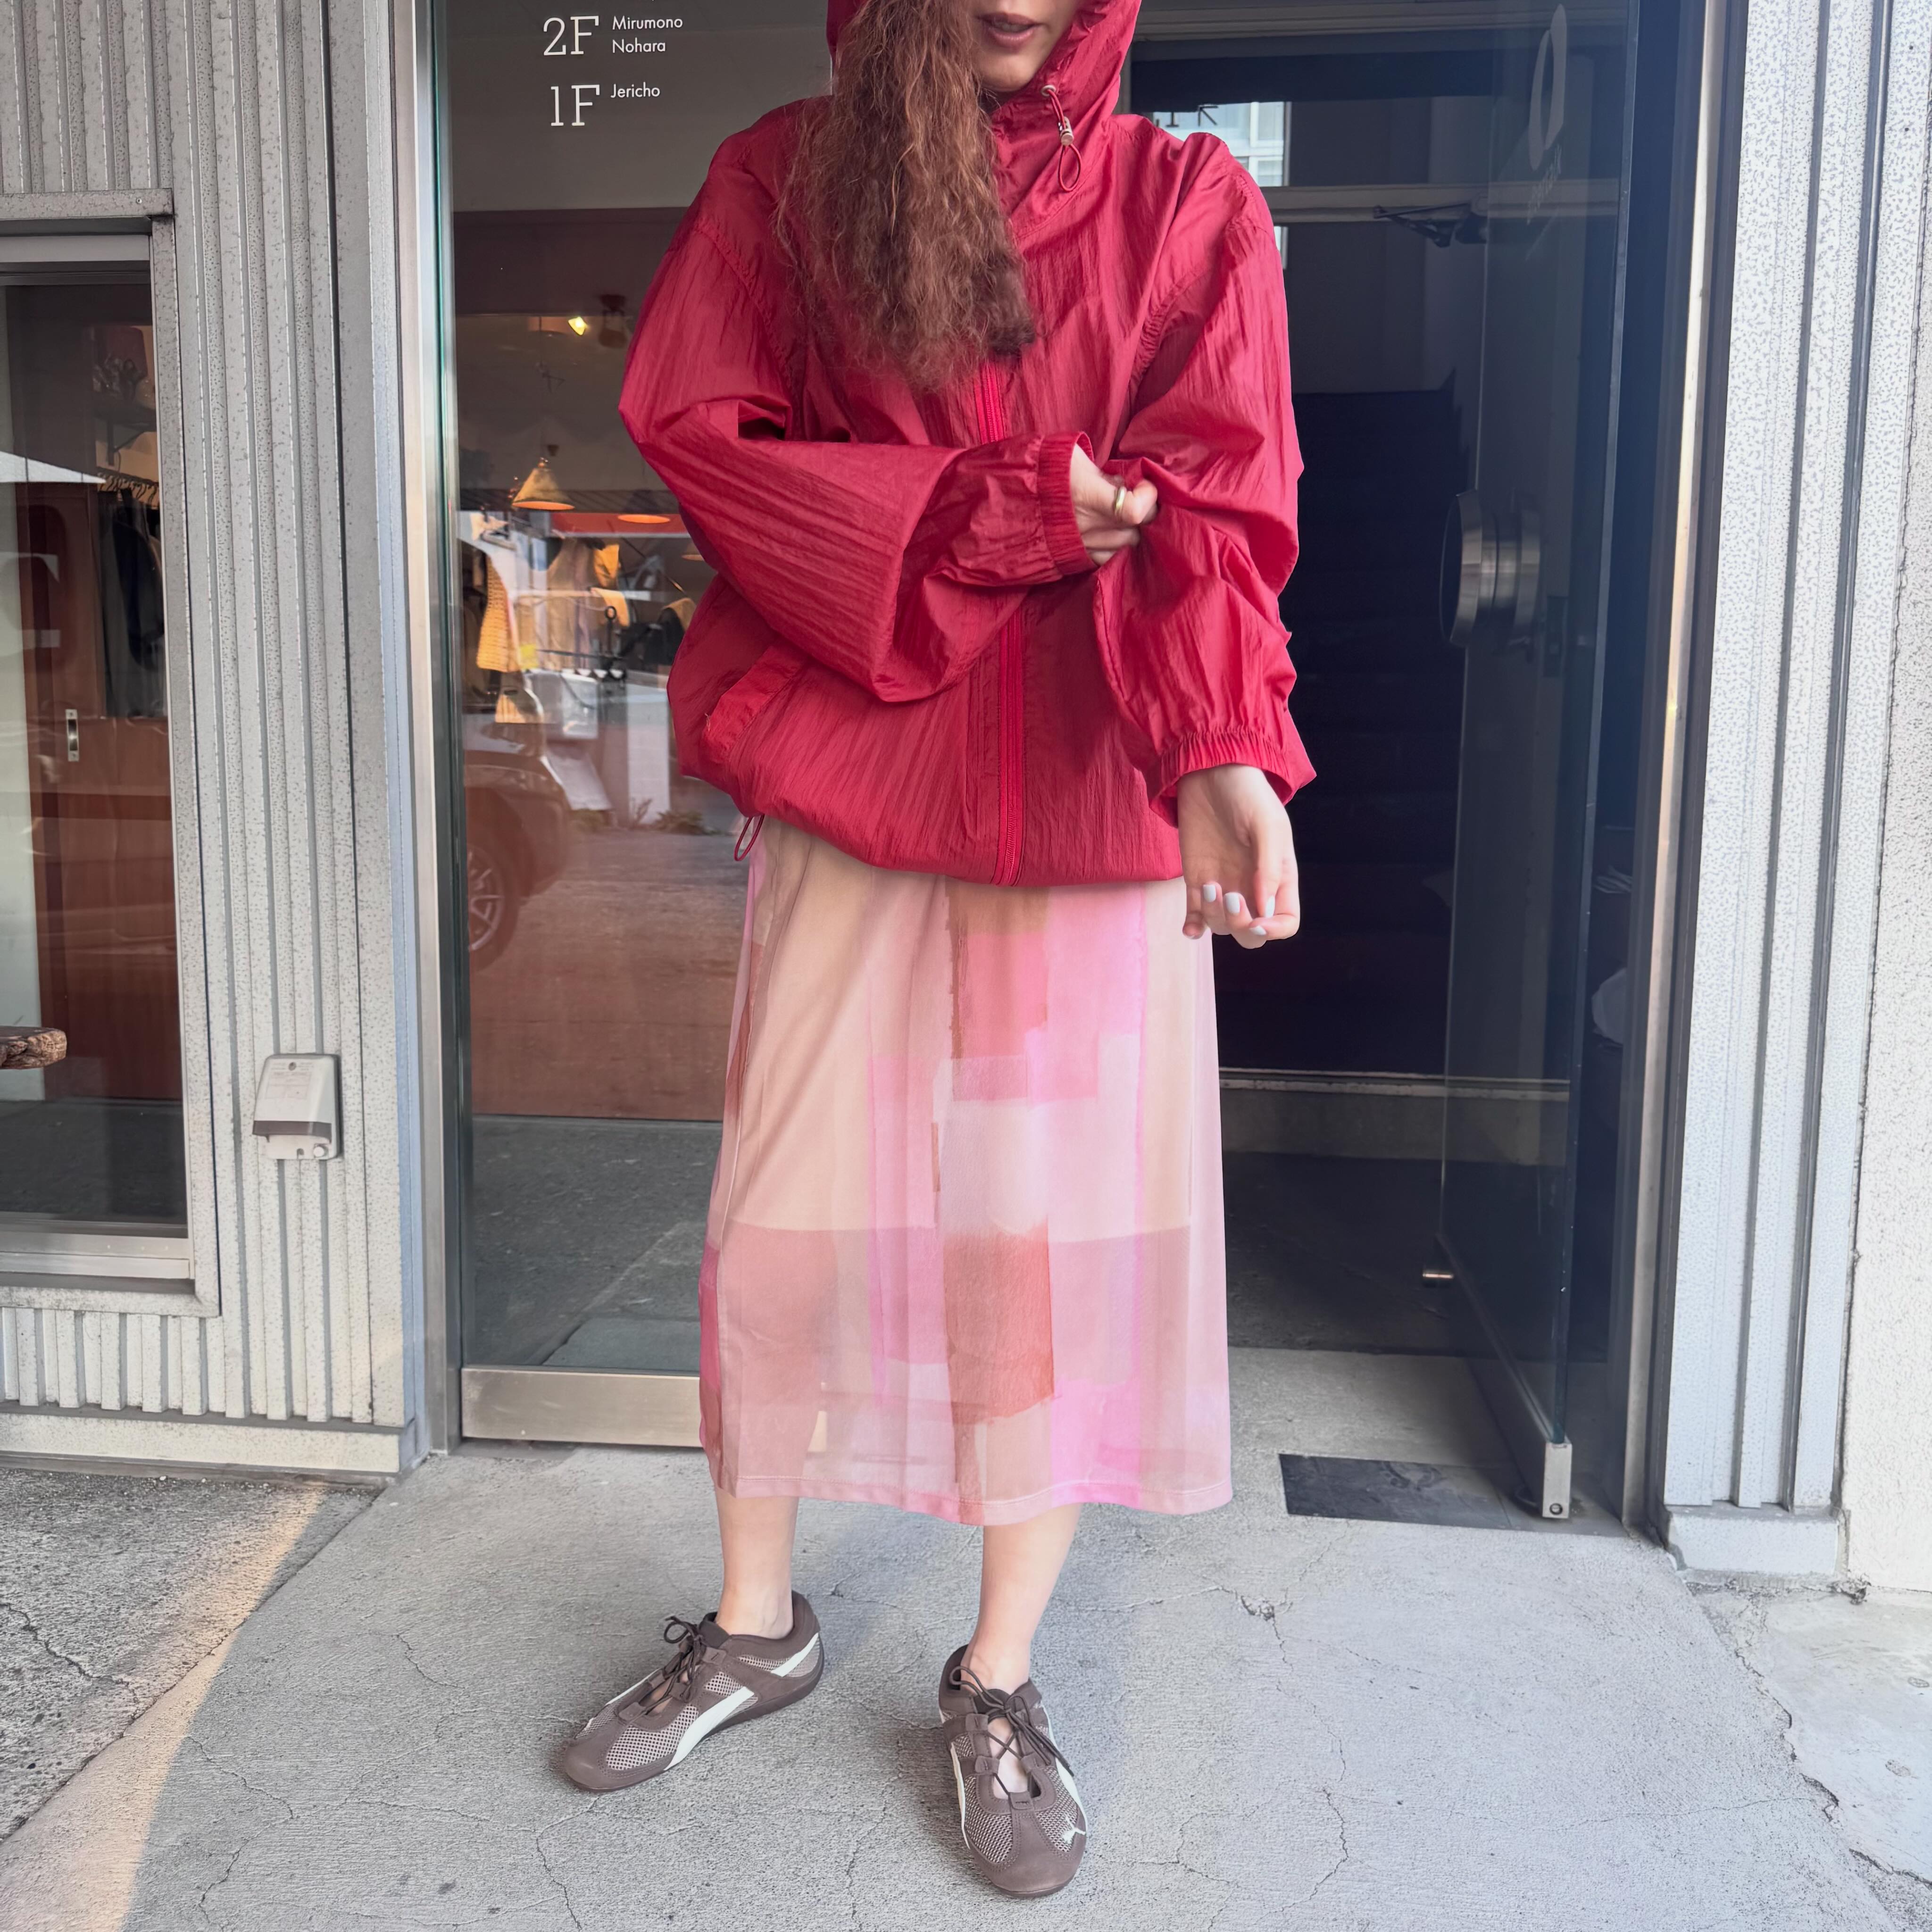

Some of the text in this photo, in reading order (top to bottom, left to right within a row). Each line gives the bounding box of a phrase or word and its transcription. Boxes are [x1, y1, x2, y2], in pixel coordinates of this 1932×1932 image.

[543, 15, 683, 56] 2F Mirumono
[612, 37, 666, 53] Nohara
[550, 82, 660, 126] 1F Jericho
